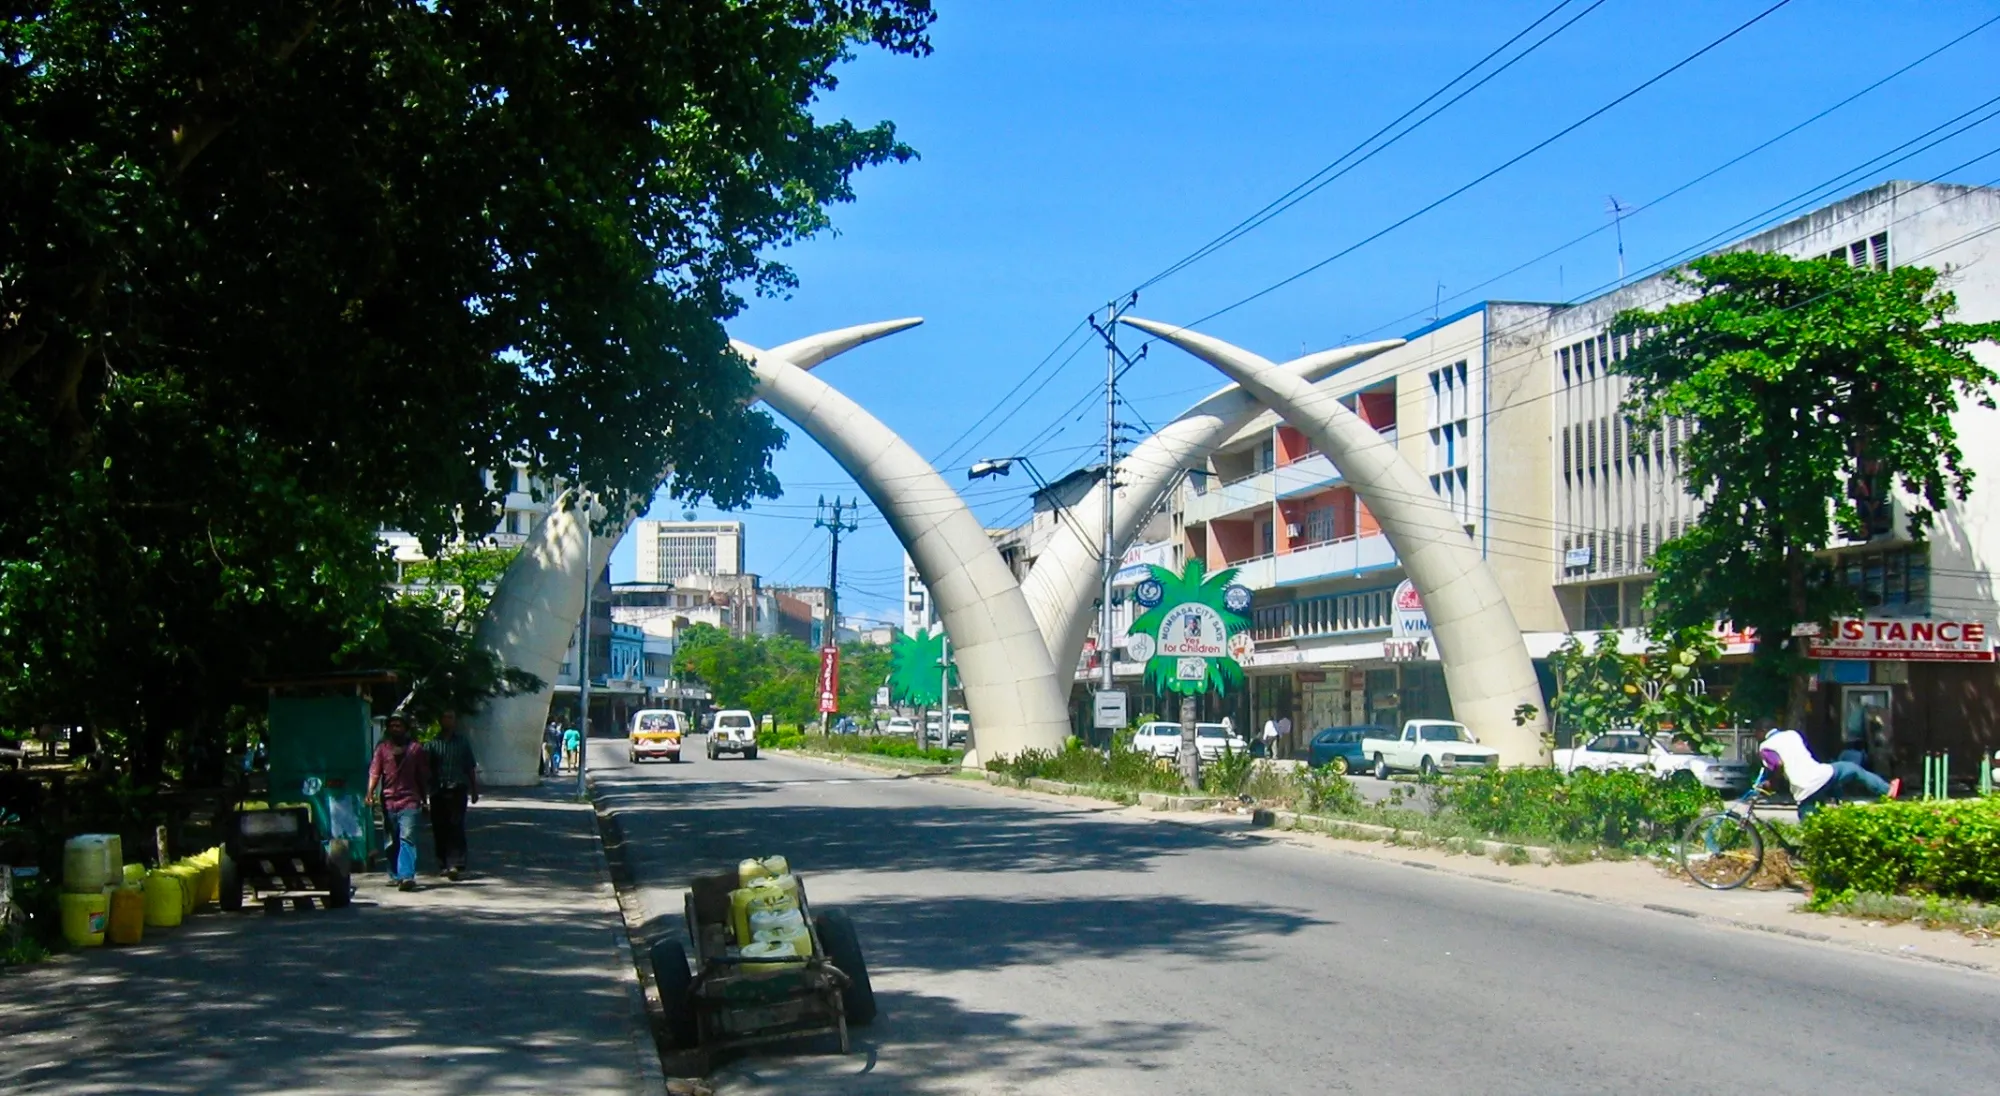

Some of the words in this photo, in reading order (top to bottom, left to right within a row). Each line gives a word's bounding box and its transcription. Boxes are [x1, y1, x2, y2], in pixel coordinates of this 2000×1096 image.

[1162, 606, 1194, 640] MOMBASA
[1195, 607, 1215, 620] CITY
[1212, 621, 1224, 642] SAYS
[1831, 620, 1985, 642] ISTANCE
[1164, 643, 1177, 653] for
[1179, 643, 1220, 653] Children
[1184, 637, 1200, 645] Yes
